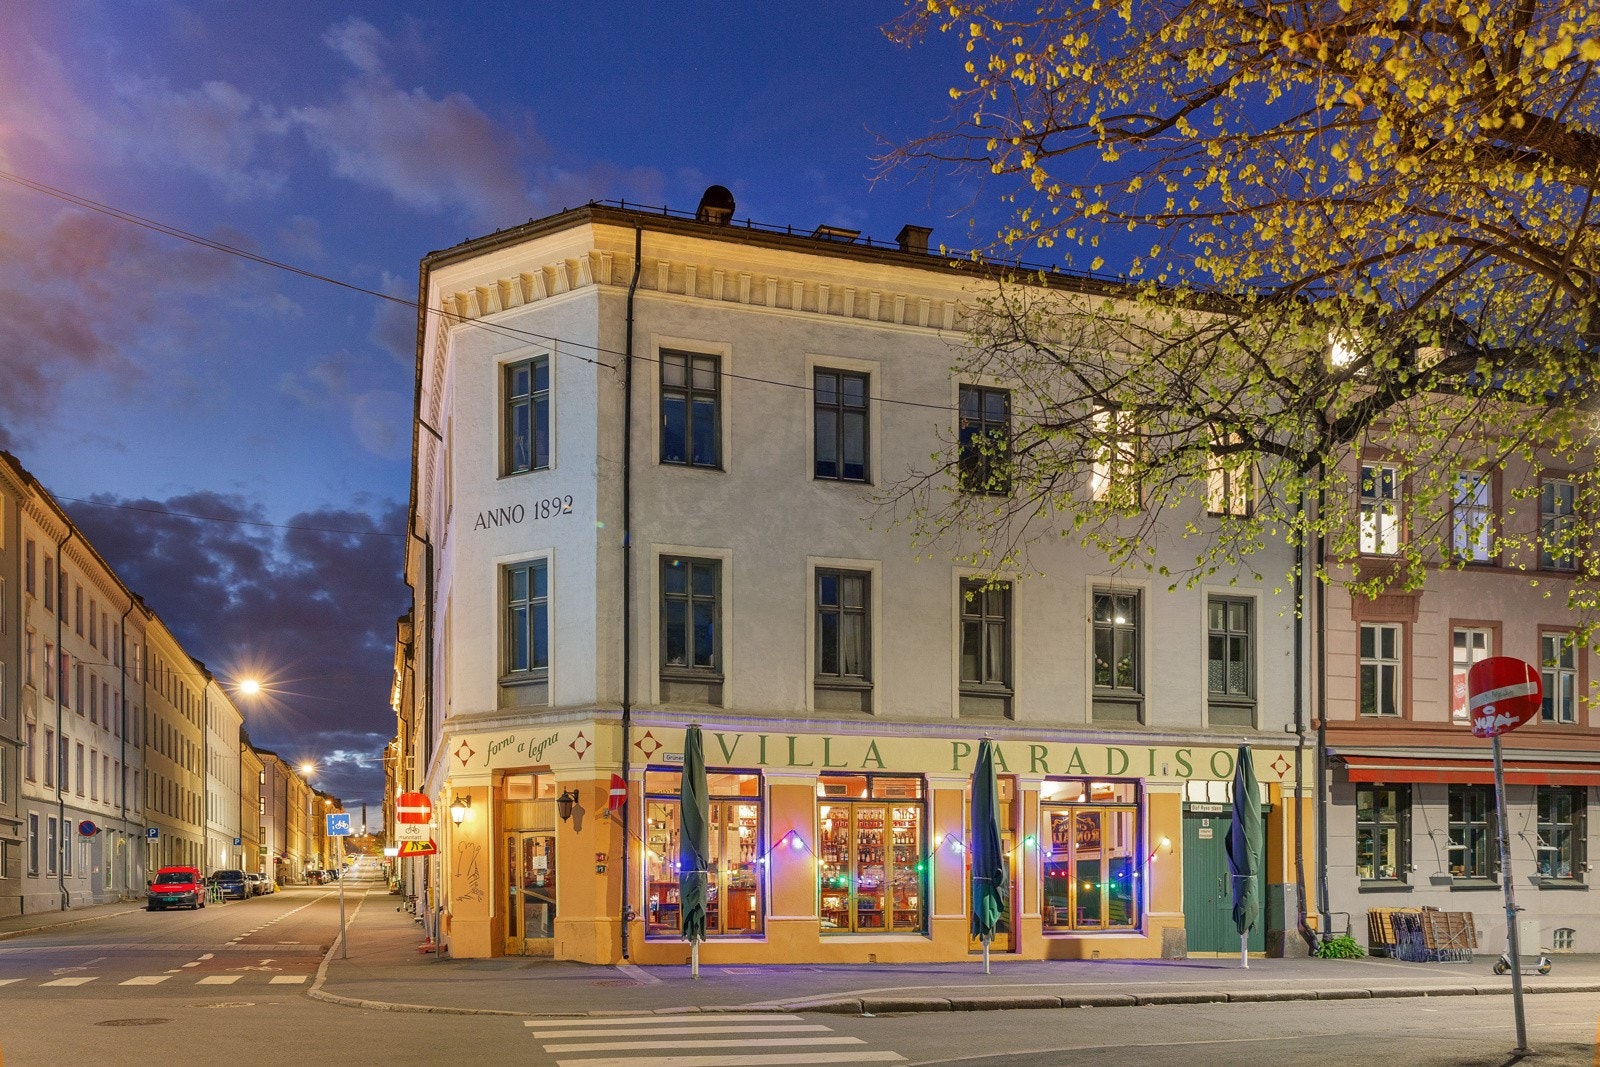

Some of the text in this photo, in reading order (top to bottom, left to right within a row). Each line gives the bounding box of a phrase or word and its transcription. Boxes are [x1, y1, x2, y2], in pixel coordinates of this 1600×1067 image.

[473, 494, 574, 531] ANNO 1892
[483, 731, 559, 768] forno a legna
[666, 753, 685, 761] Grüner
[713, 732, 1235, 779] VILLA PARADISO
